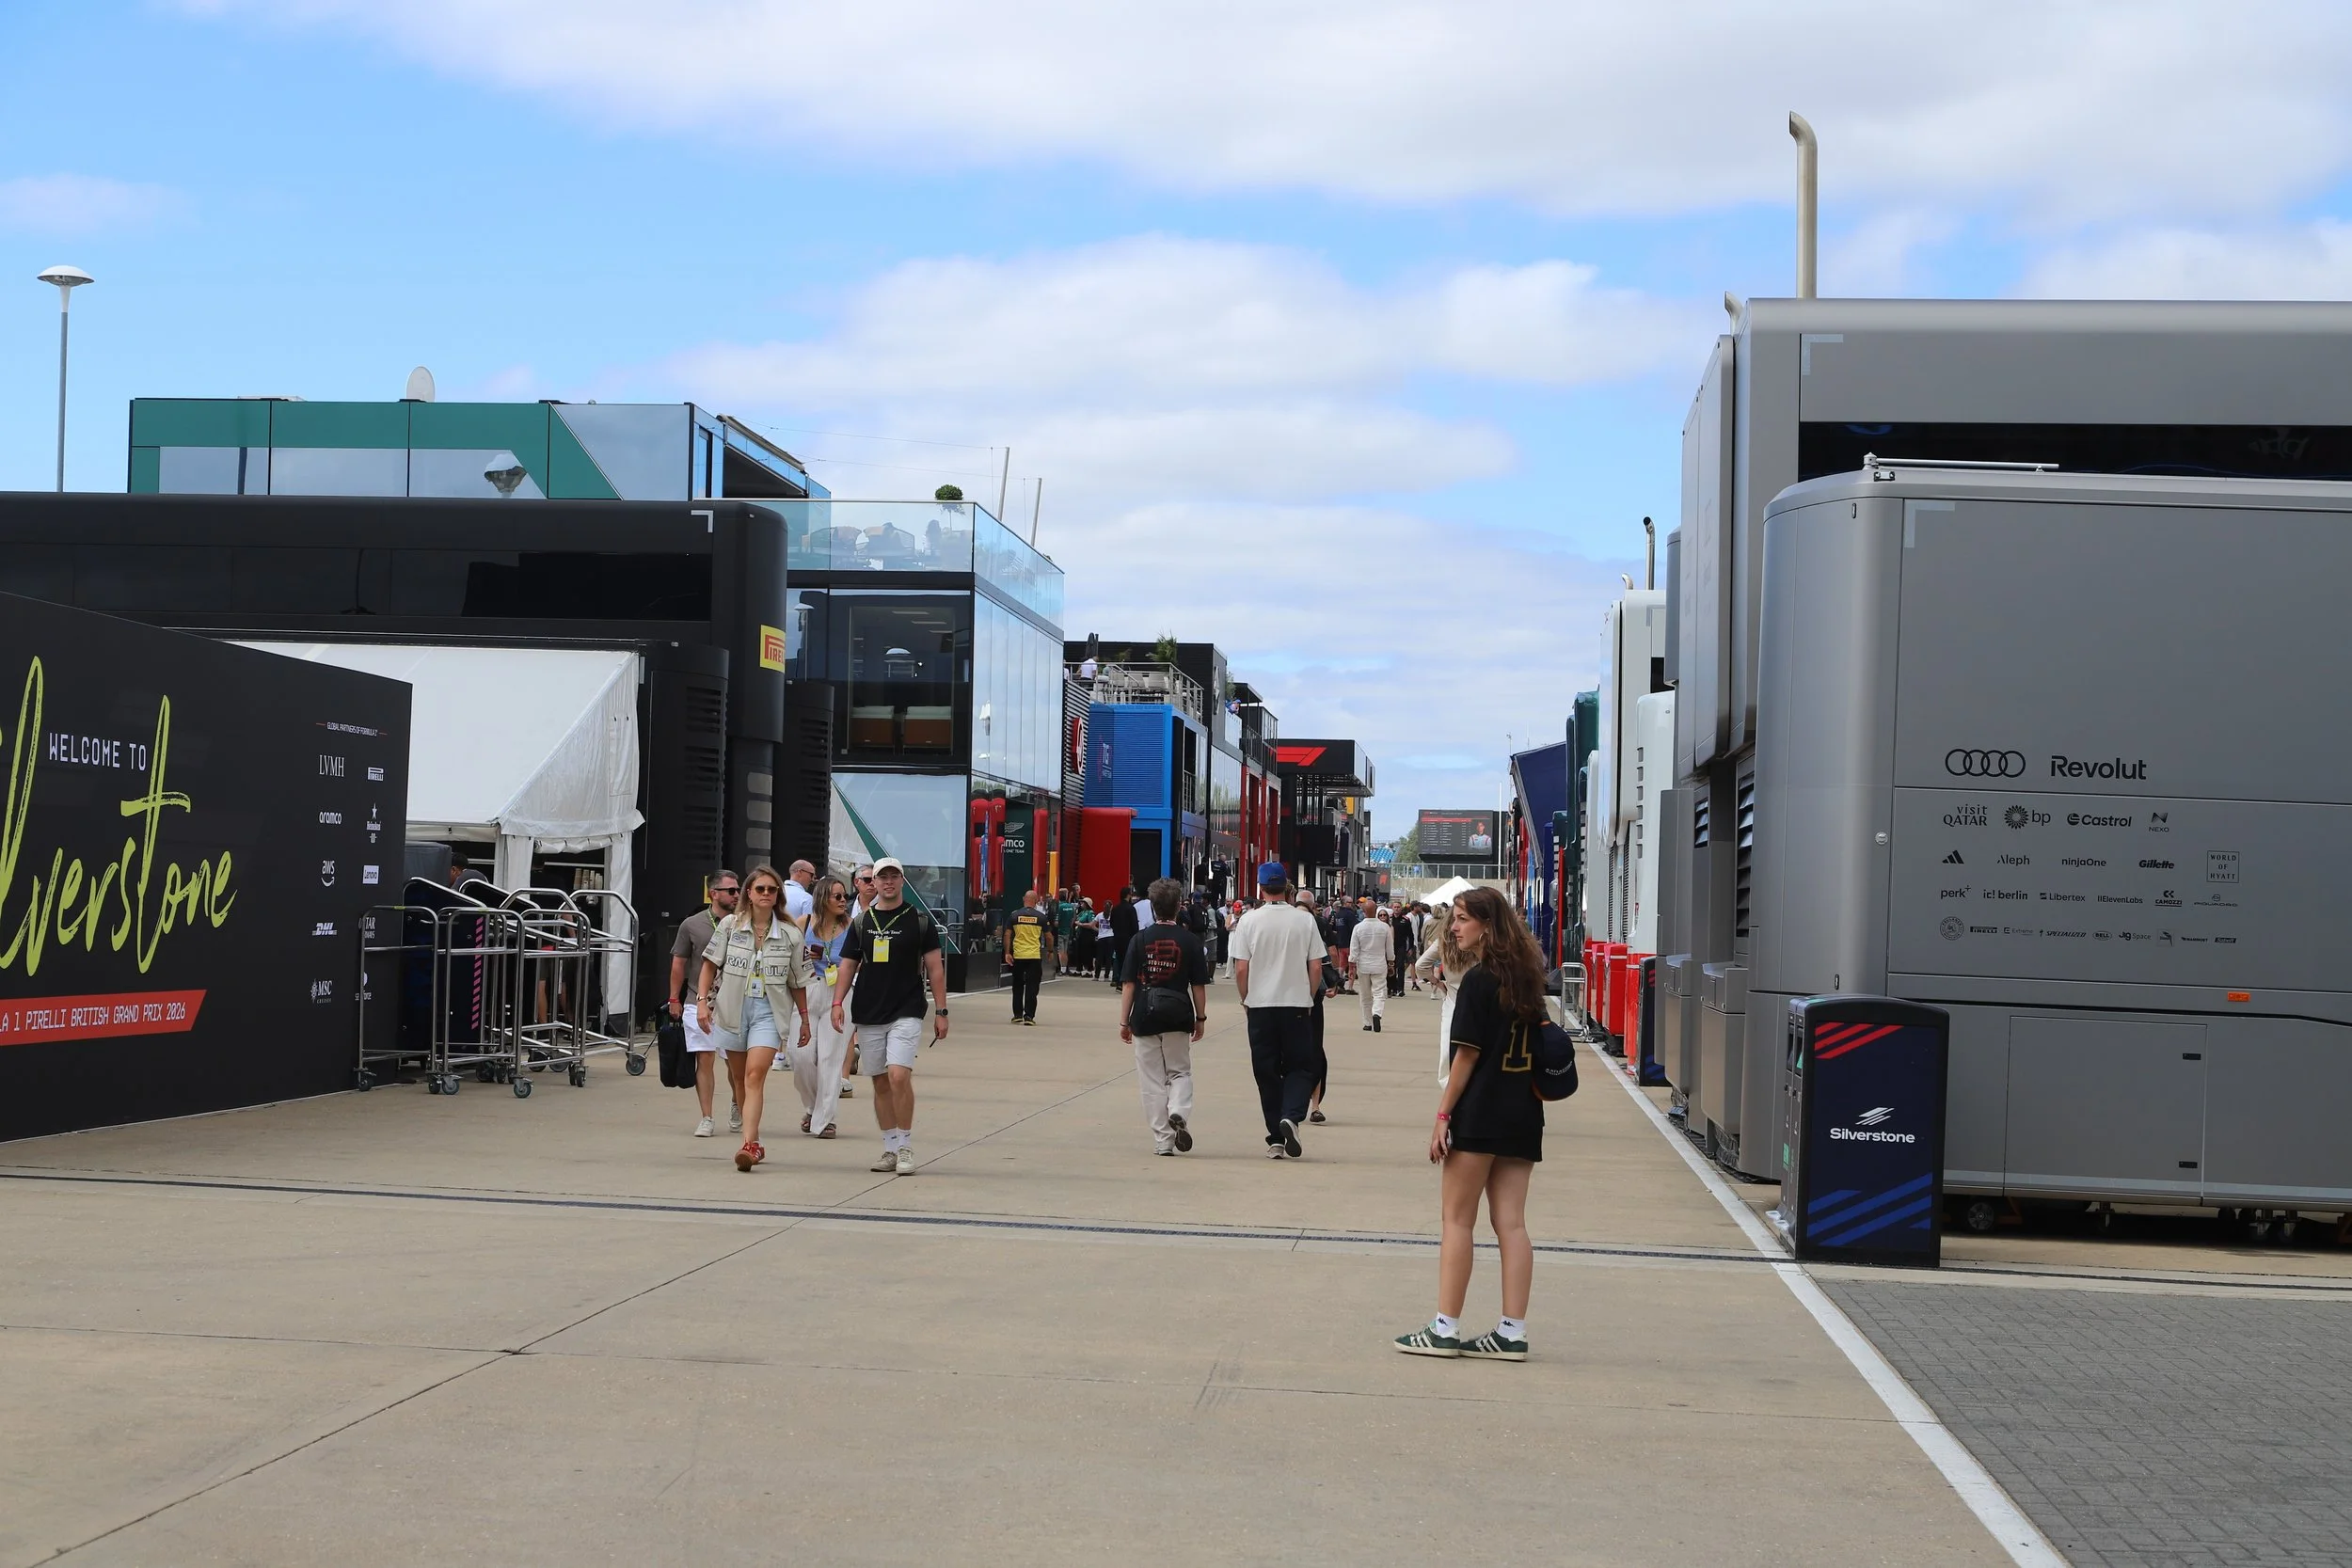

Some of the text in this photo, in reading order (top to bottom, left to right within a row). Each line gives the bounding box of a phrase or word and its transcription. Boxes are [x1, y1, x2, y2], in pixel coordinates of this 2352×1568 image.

[49, 732, 147, 771] WELCOME TO
[319, 755, 345, 777] LVMH
[2050, 755, 2147, 780] Revolut
[368, 767, 384, 781] PIRELLI
[0, 656, 237, 976] lverstone
[1957, 804, 1987, 815] visit
[319, 812, 342, 824] aramco
[1943, 814, 1987, 827] QATAR
[2032, 810, 2051, 826] bp
[2081, 814, 2132, 827] Castrol
[322, 860, 335, 874] aws
[1997, 855, 2030, 866] Aleph
[2062, 857, 2107, 868] ninjaOne
[2139, 859, 2175, 869] Gillette
[1998, 890, 2028, 900] berlin
[2050, 893, 2085, 902] Libertex
[315, 922, 335, 935] DHL
[358, 917, 376, 929] QTAR
[318, 980, 332, 996] MSC
[0, 1002, 186, 1032] A 1 PIRELLI BRITISH GRAND PRIX 2026
[1502, 1020, 1532, 1072] 1
[1830, 1128, 1915, 1143] Silverstone
